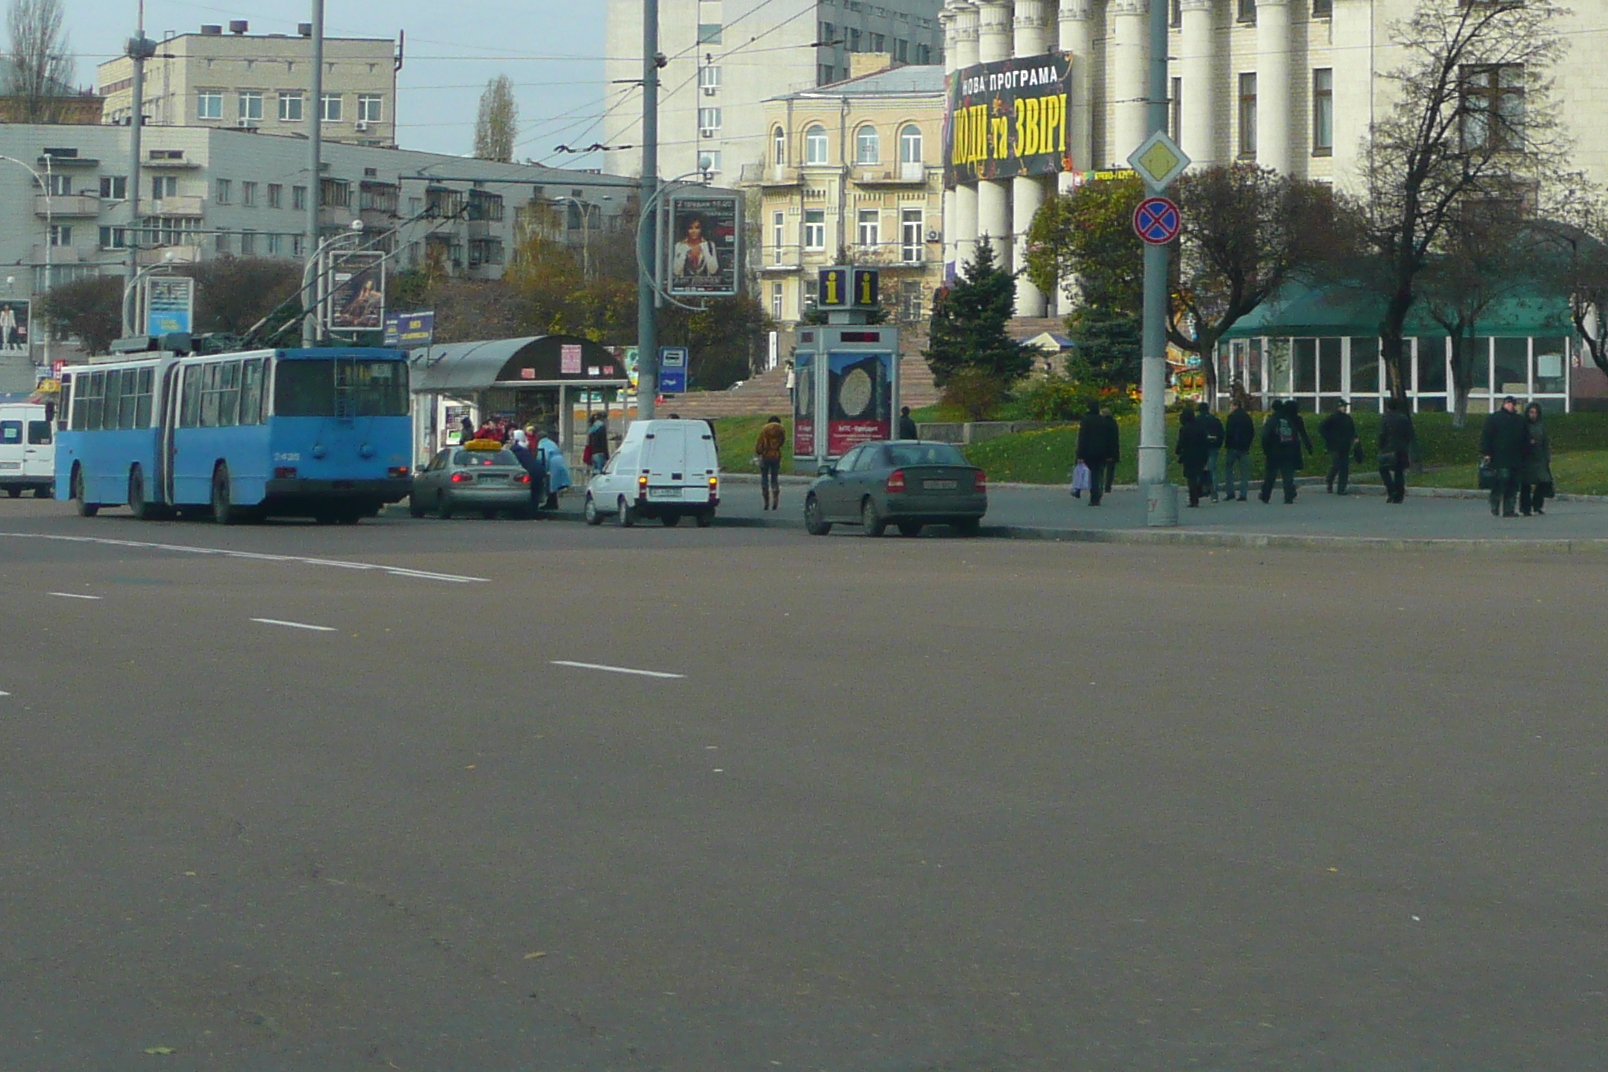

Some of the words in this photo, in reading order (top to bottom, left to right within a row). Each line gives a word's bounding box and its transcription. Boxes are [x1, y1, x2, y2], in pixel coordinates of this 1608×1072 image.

[962, 75, 986, 96] НОВА
[989, 65, 1058, 91] ПРОГРАМА
[991, 116, 1008, 159] та
[1013, 93, 1067, 157] ЗВІРІ
